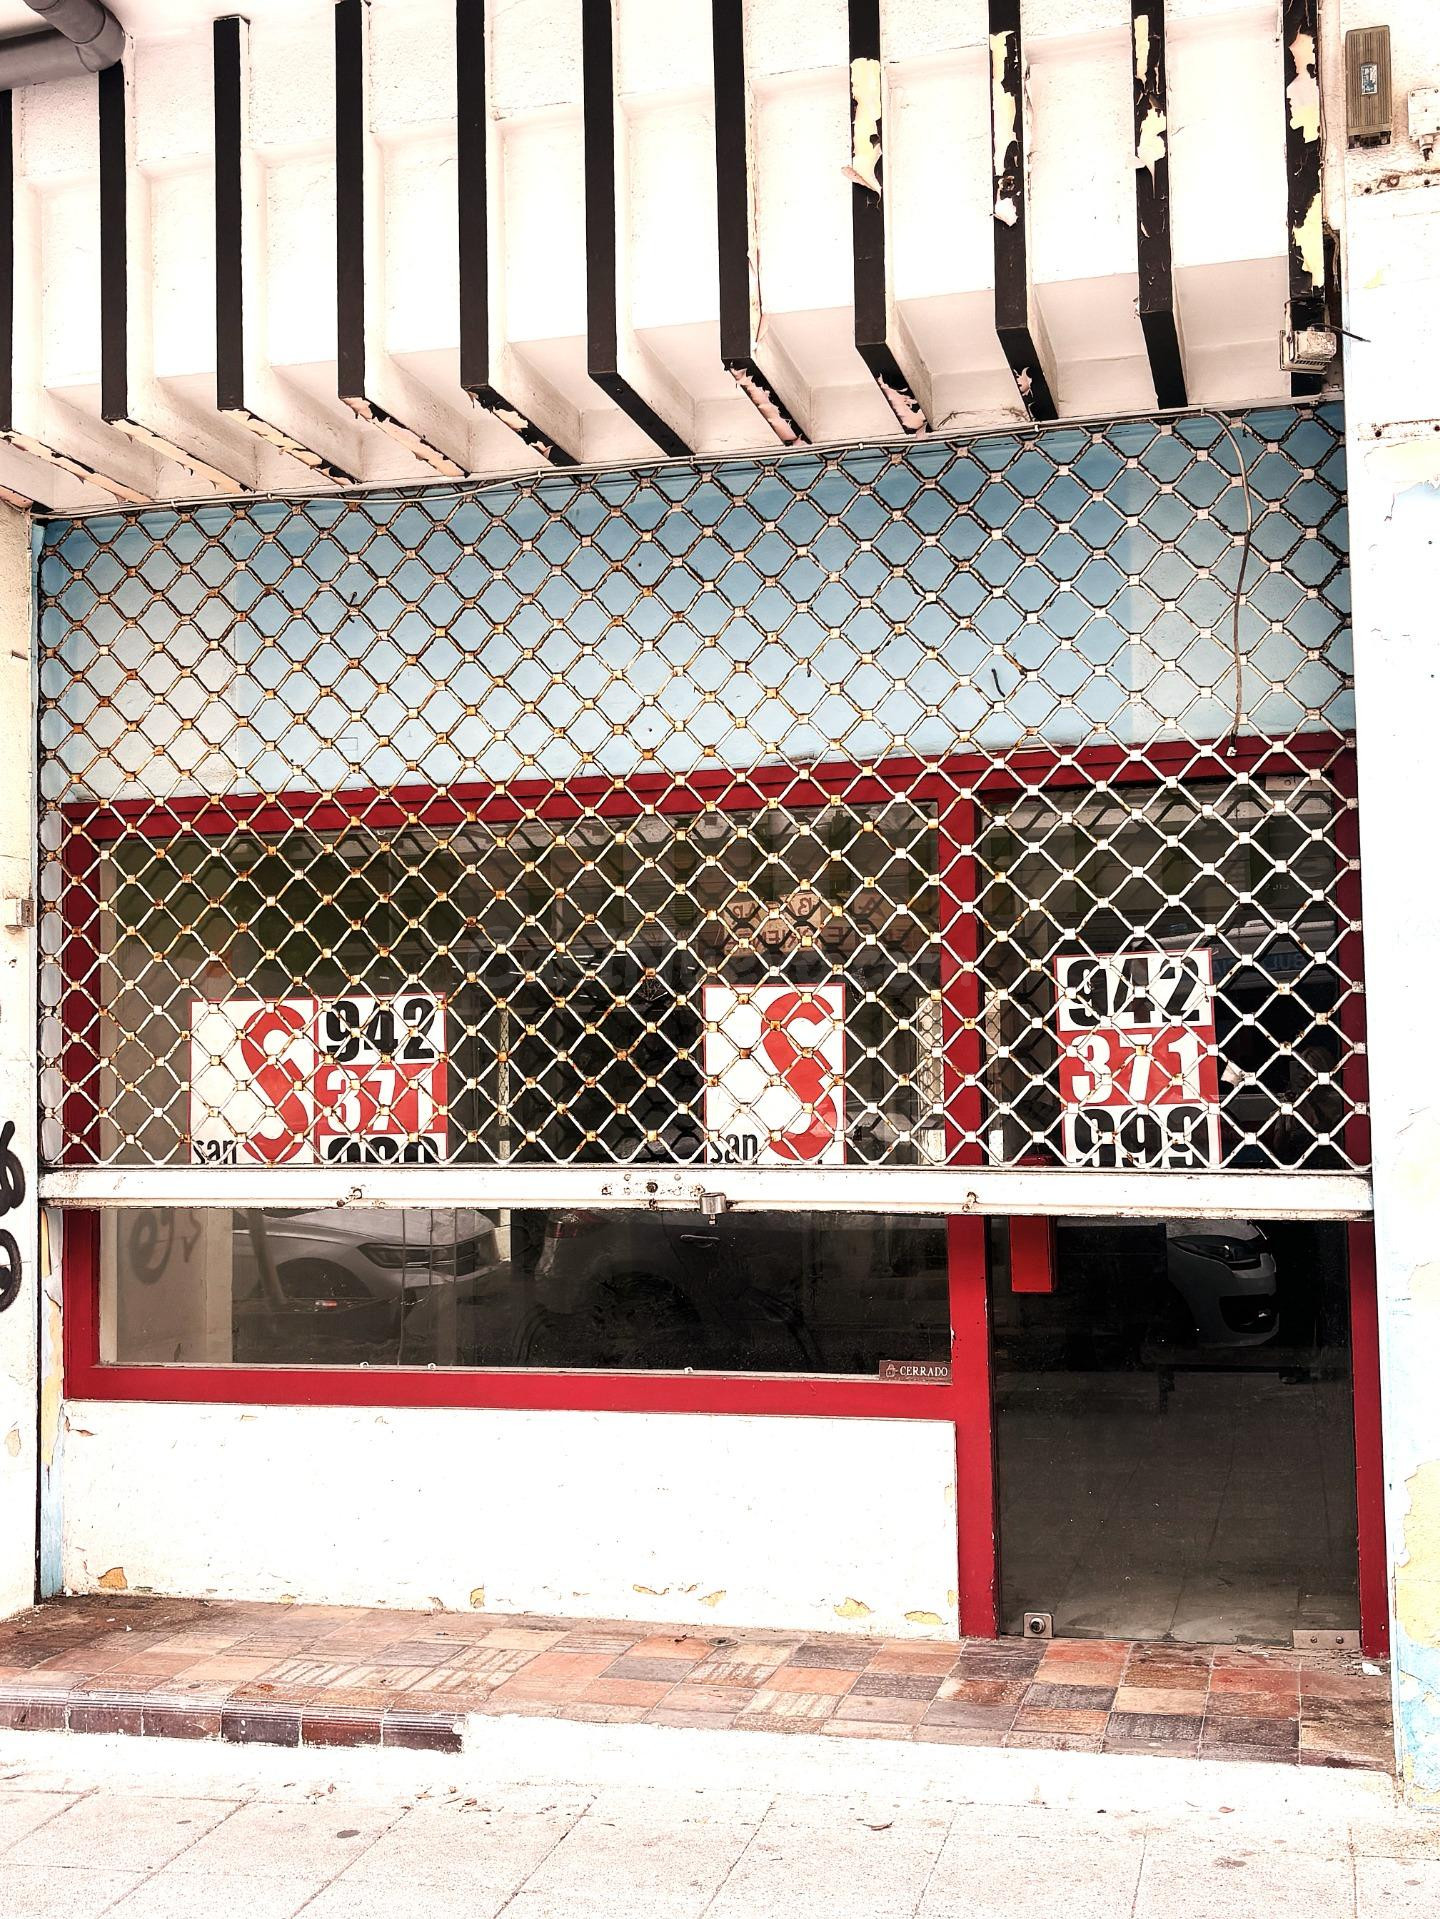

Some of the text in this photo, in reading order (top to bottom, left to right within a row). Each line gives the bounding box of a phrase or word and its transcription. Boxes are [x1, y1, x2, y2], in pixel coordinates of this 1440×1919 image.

[1067, 955, 1201, 1027] 942
[325, 997, 436, 1063] 942
[325, 1068, 434, 1133] 371
[1070, 1032, 1201, 1104] 371
[1074, 1105, 1210, 1168] 999
[900, 1365, 948, 1377] CERRADO
